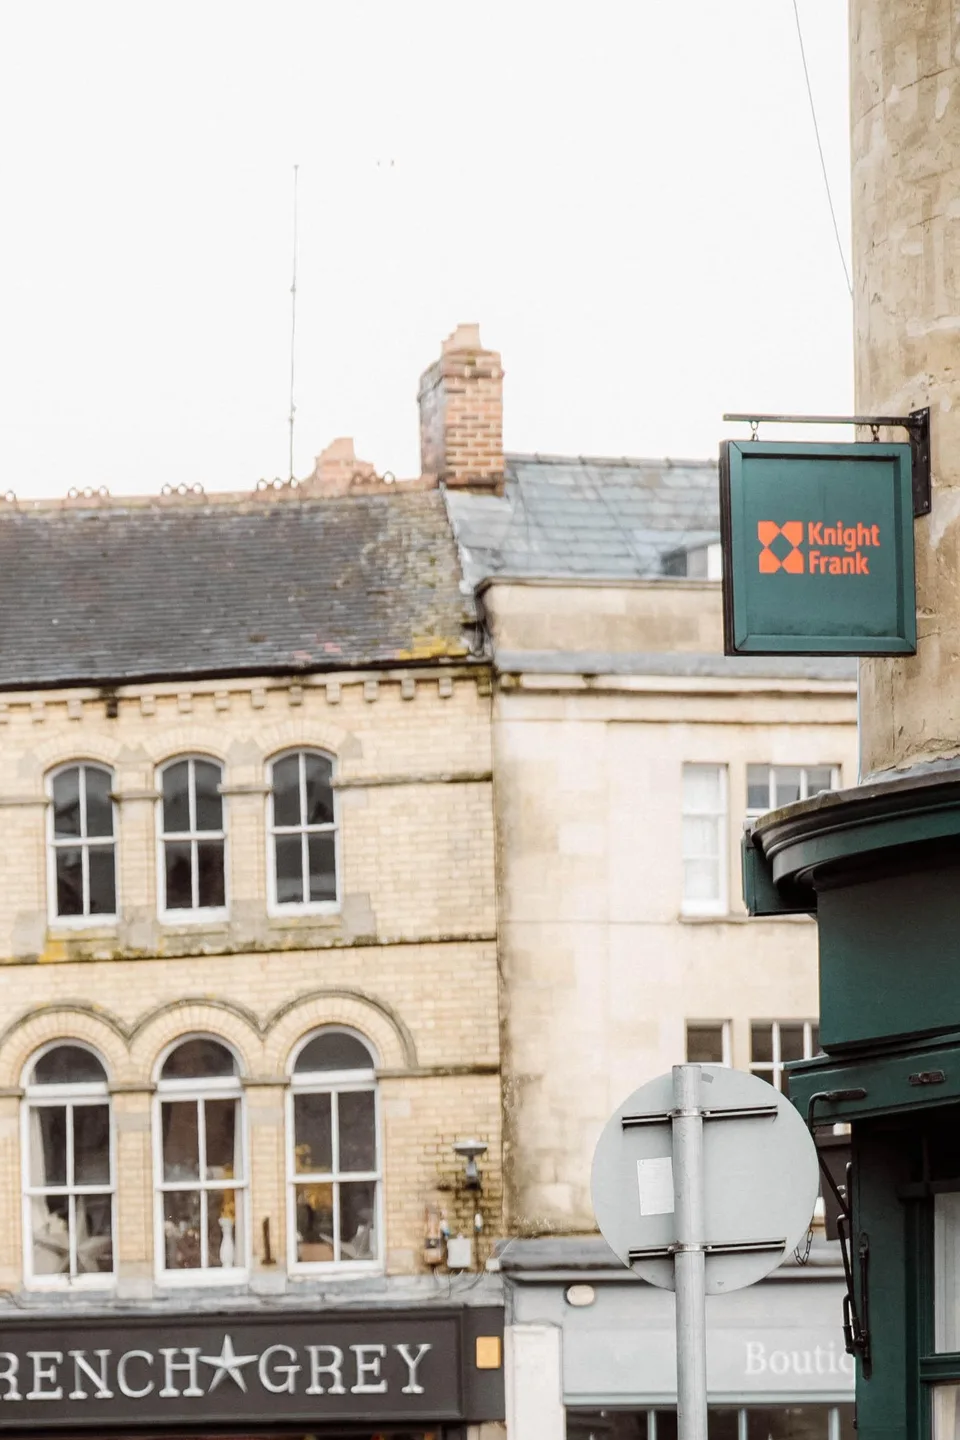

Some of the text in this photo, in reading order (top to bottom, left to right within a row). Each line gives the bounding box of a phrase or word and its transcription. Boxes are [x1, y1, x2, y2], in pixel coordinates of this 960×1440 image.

[808, 520, 881, 552] Knight
[809, 550, 870, 575] Frank
[258, 1344, 433, 1394] GREY
